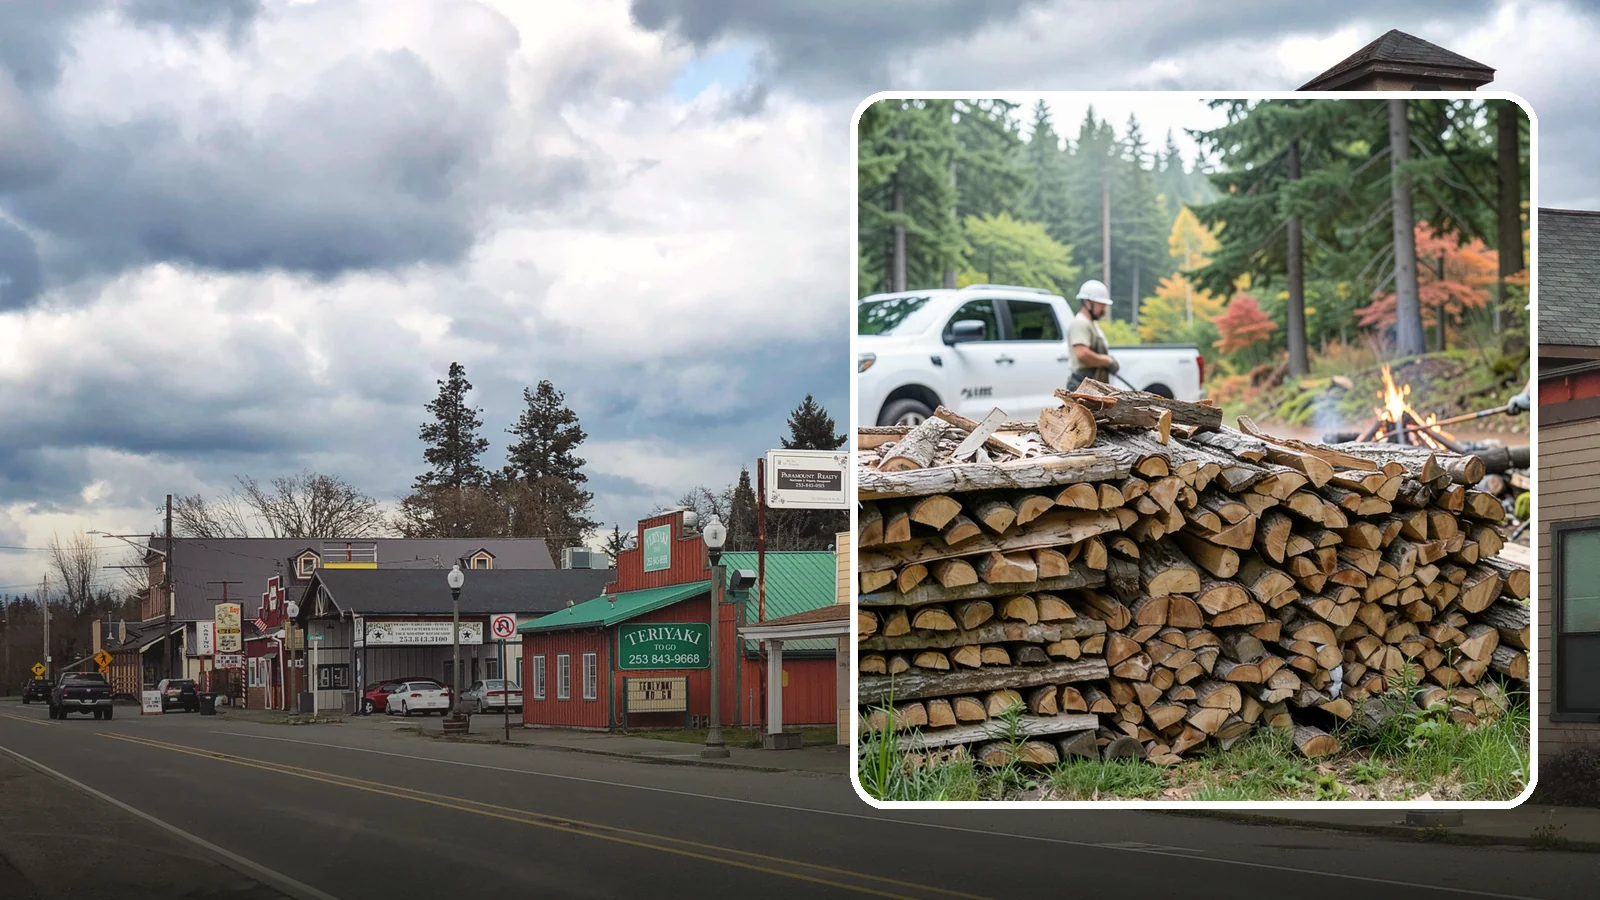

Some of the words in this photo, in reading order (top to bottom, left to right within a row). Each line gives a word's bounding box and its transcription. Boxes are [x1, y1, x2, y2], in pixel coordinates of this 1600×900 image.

[624, 627, 702, 646] TERIYAKI
[629, 655, 648, 664] 253
[652, 654, 700, 663] 843-9668
